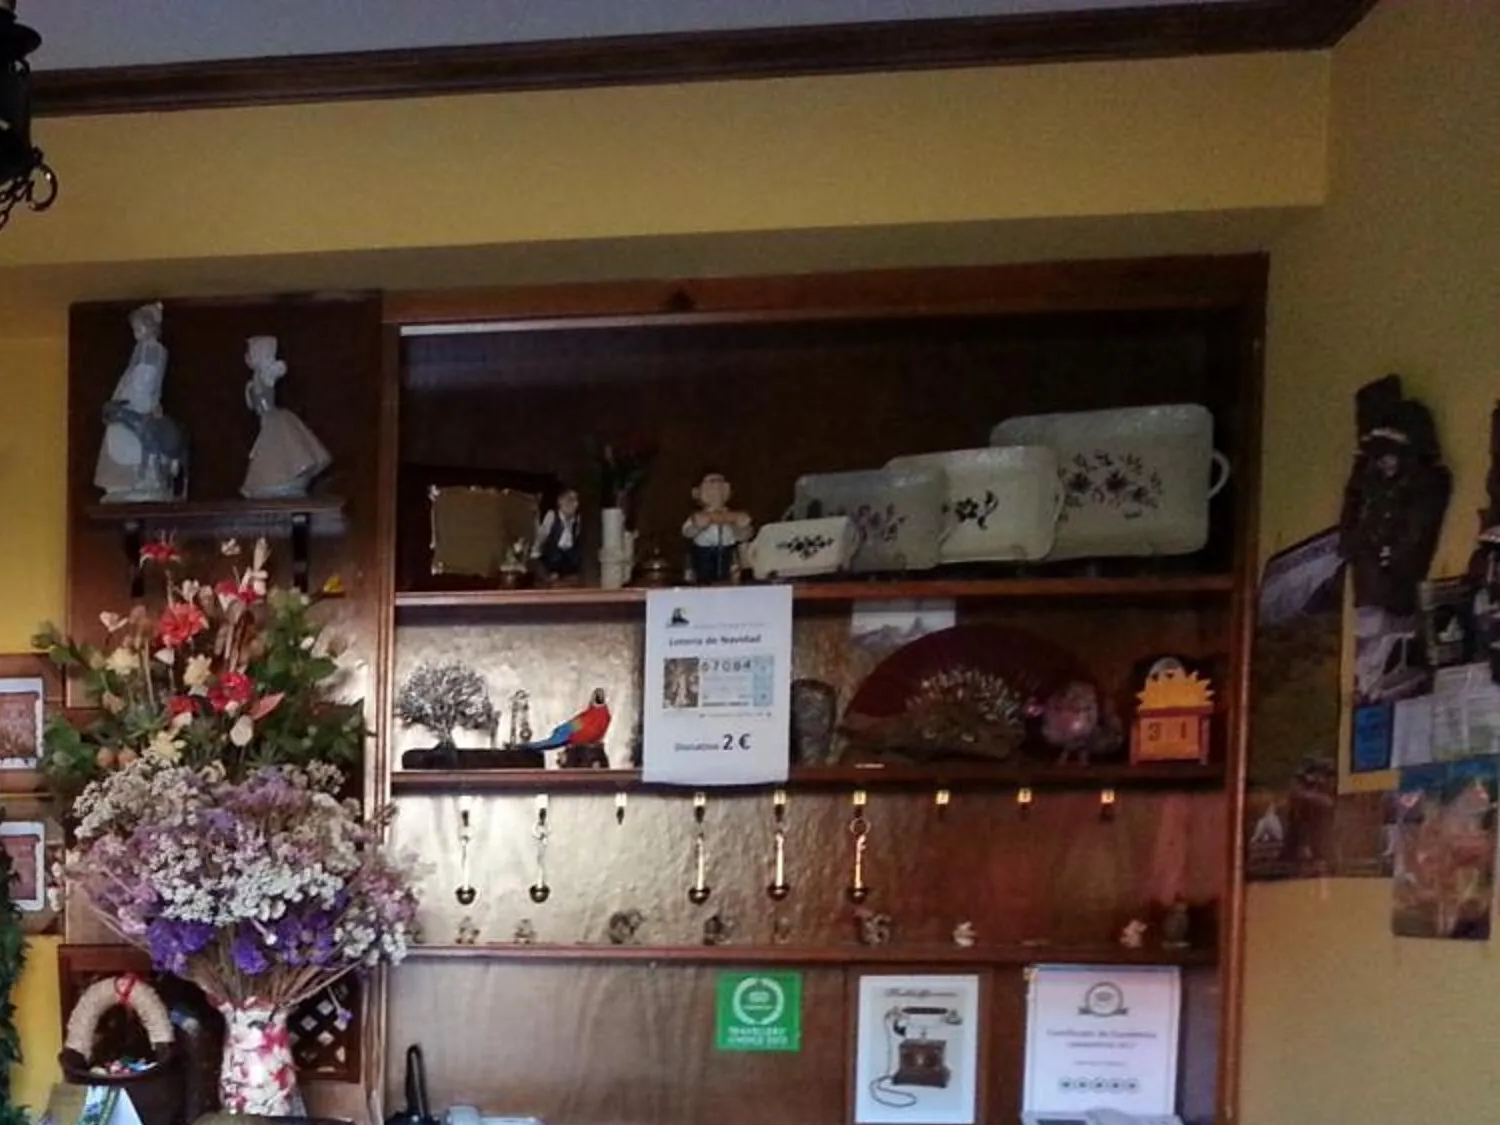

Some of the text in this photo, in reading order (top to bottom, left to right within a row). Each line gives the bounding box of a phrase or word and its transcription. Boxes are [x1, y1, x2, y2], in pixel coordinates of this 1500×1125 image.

[705, 636, 718, 646] de
[720, 633, 762, 645] Navidad
[722, 733, 734, 751] 2
[738, 732, 752, 751] €
